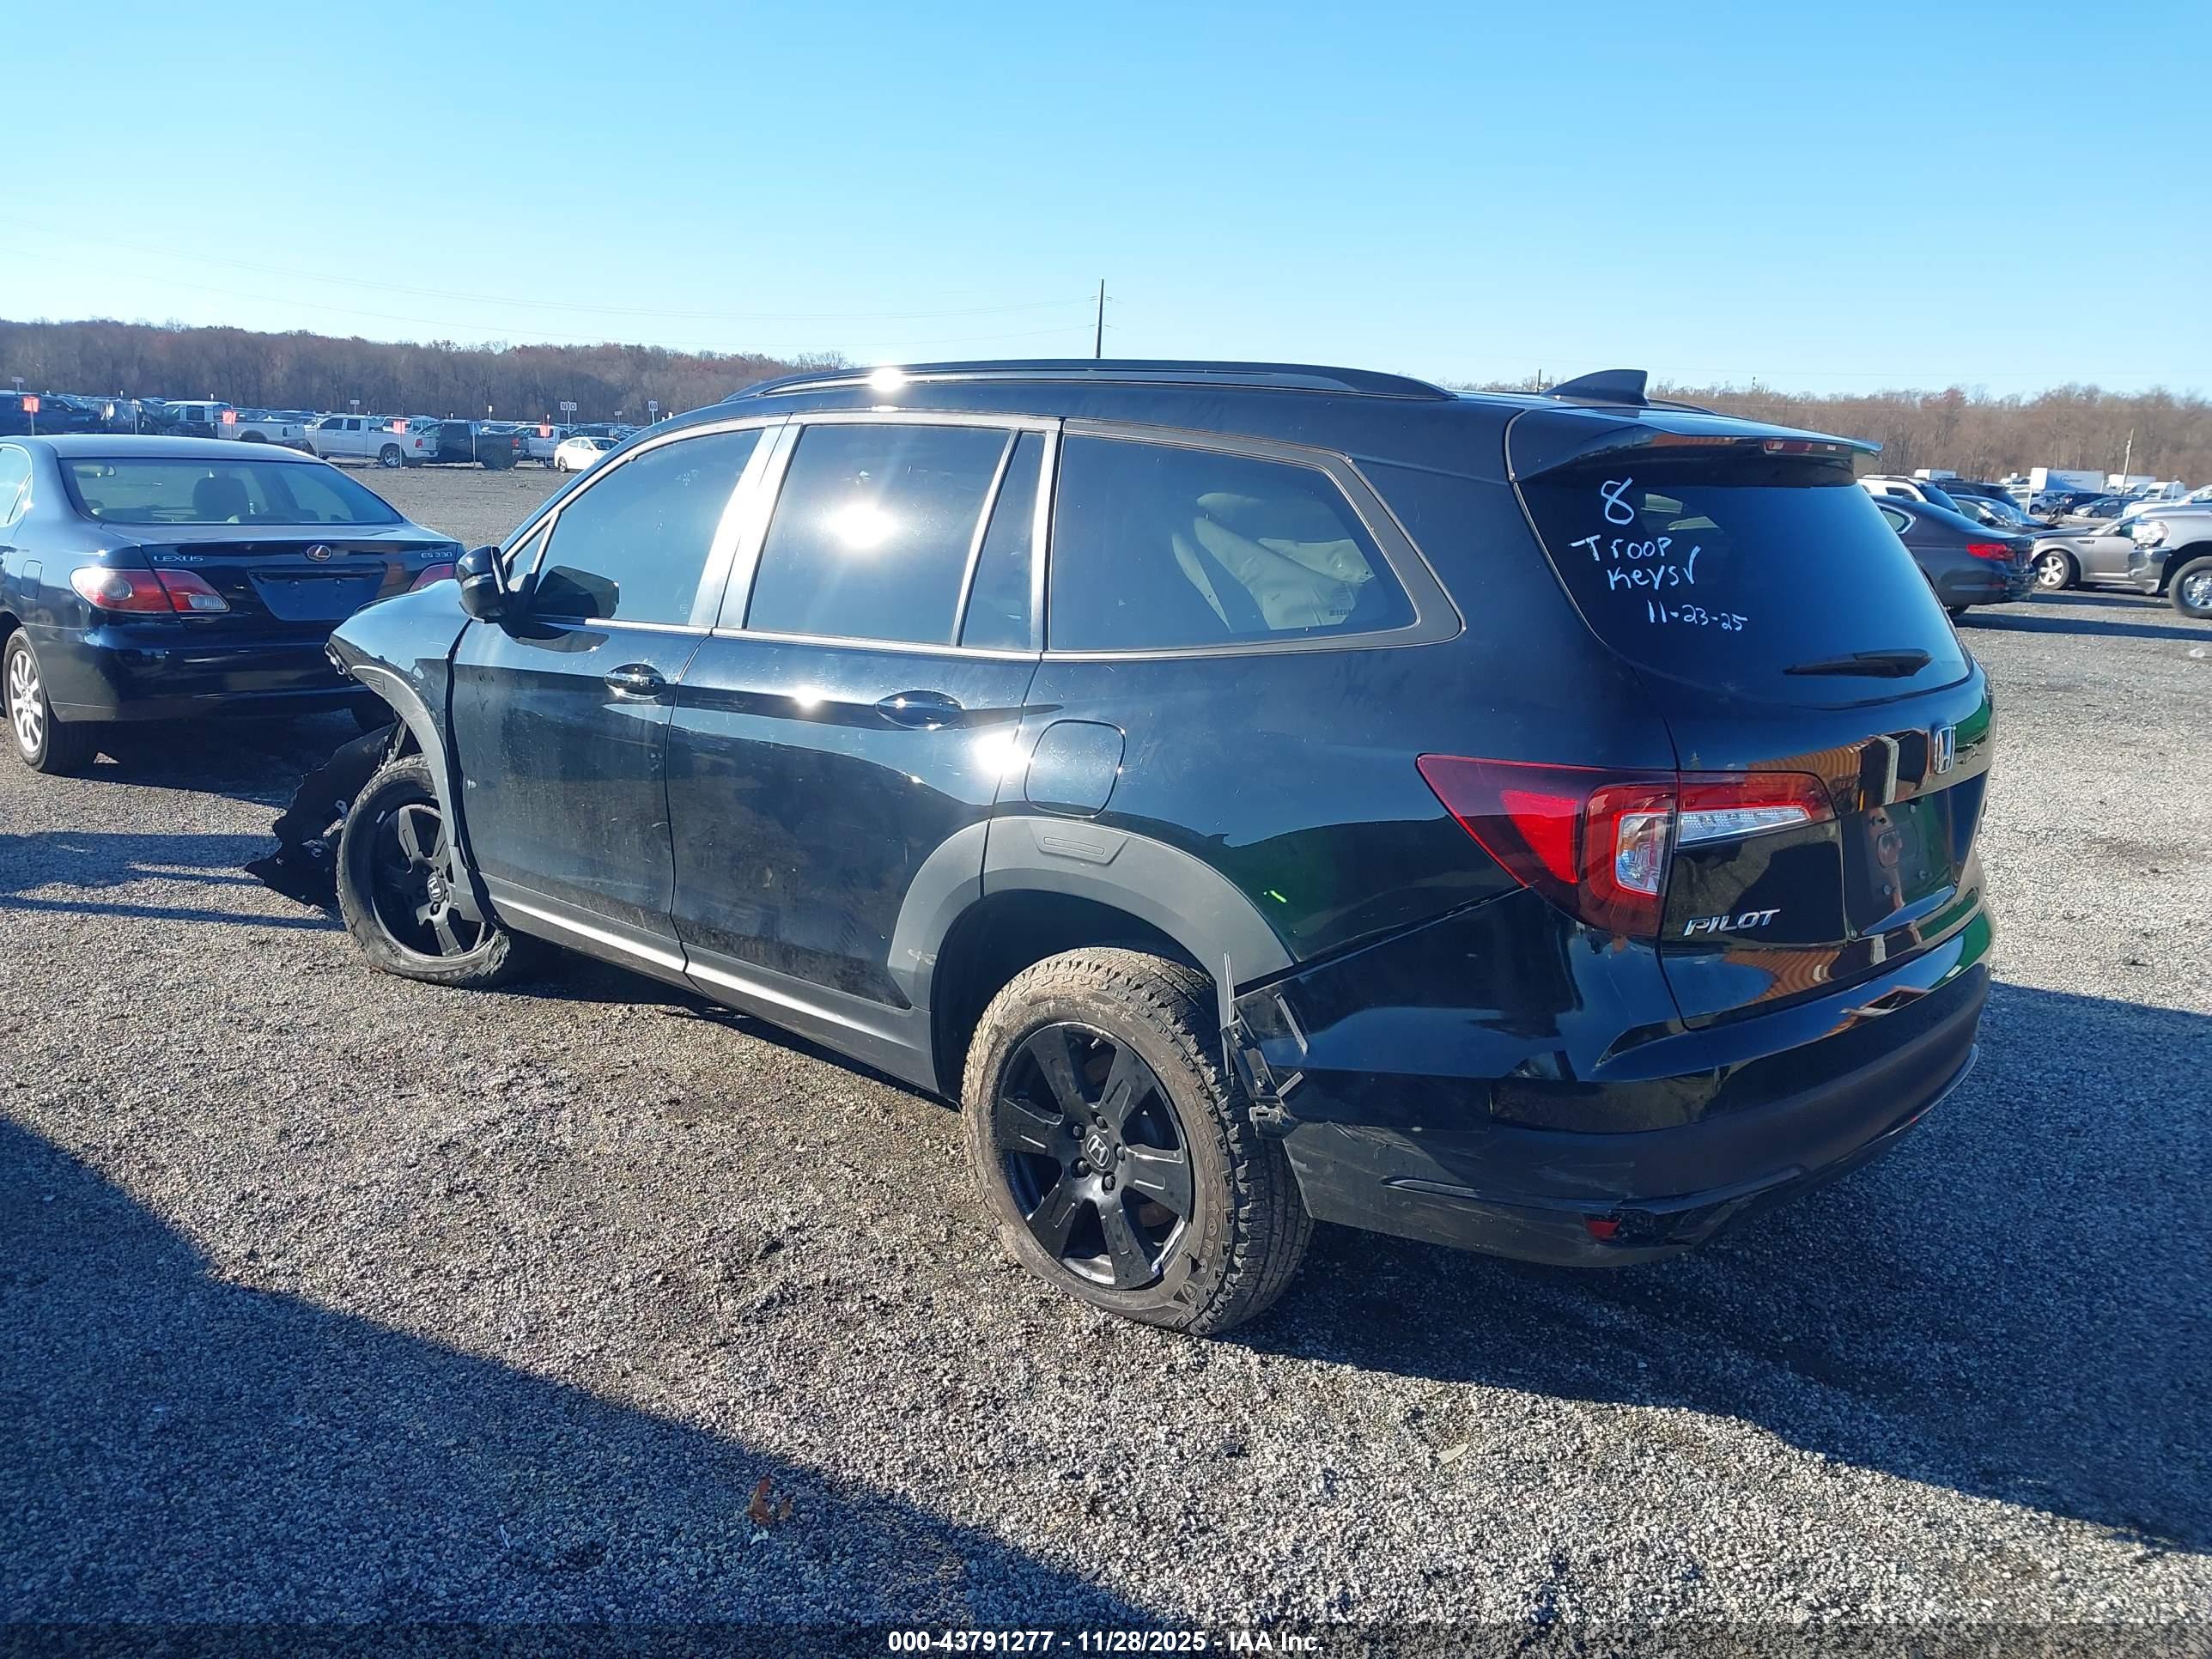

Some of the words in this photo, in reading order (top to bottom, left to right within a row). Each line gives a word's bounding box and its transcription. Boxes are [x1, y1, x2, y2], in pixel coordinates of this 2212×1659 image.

[1601, 477, 1634, 525] 8
[1646, 599, 1748, 632] 11-23-25
[1683, 908, 1782, 937] PILOT
